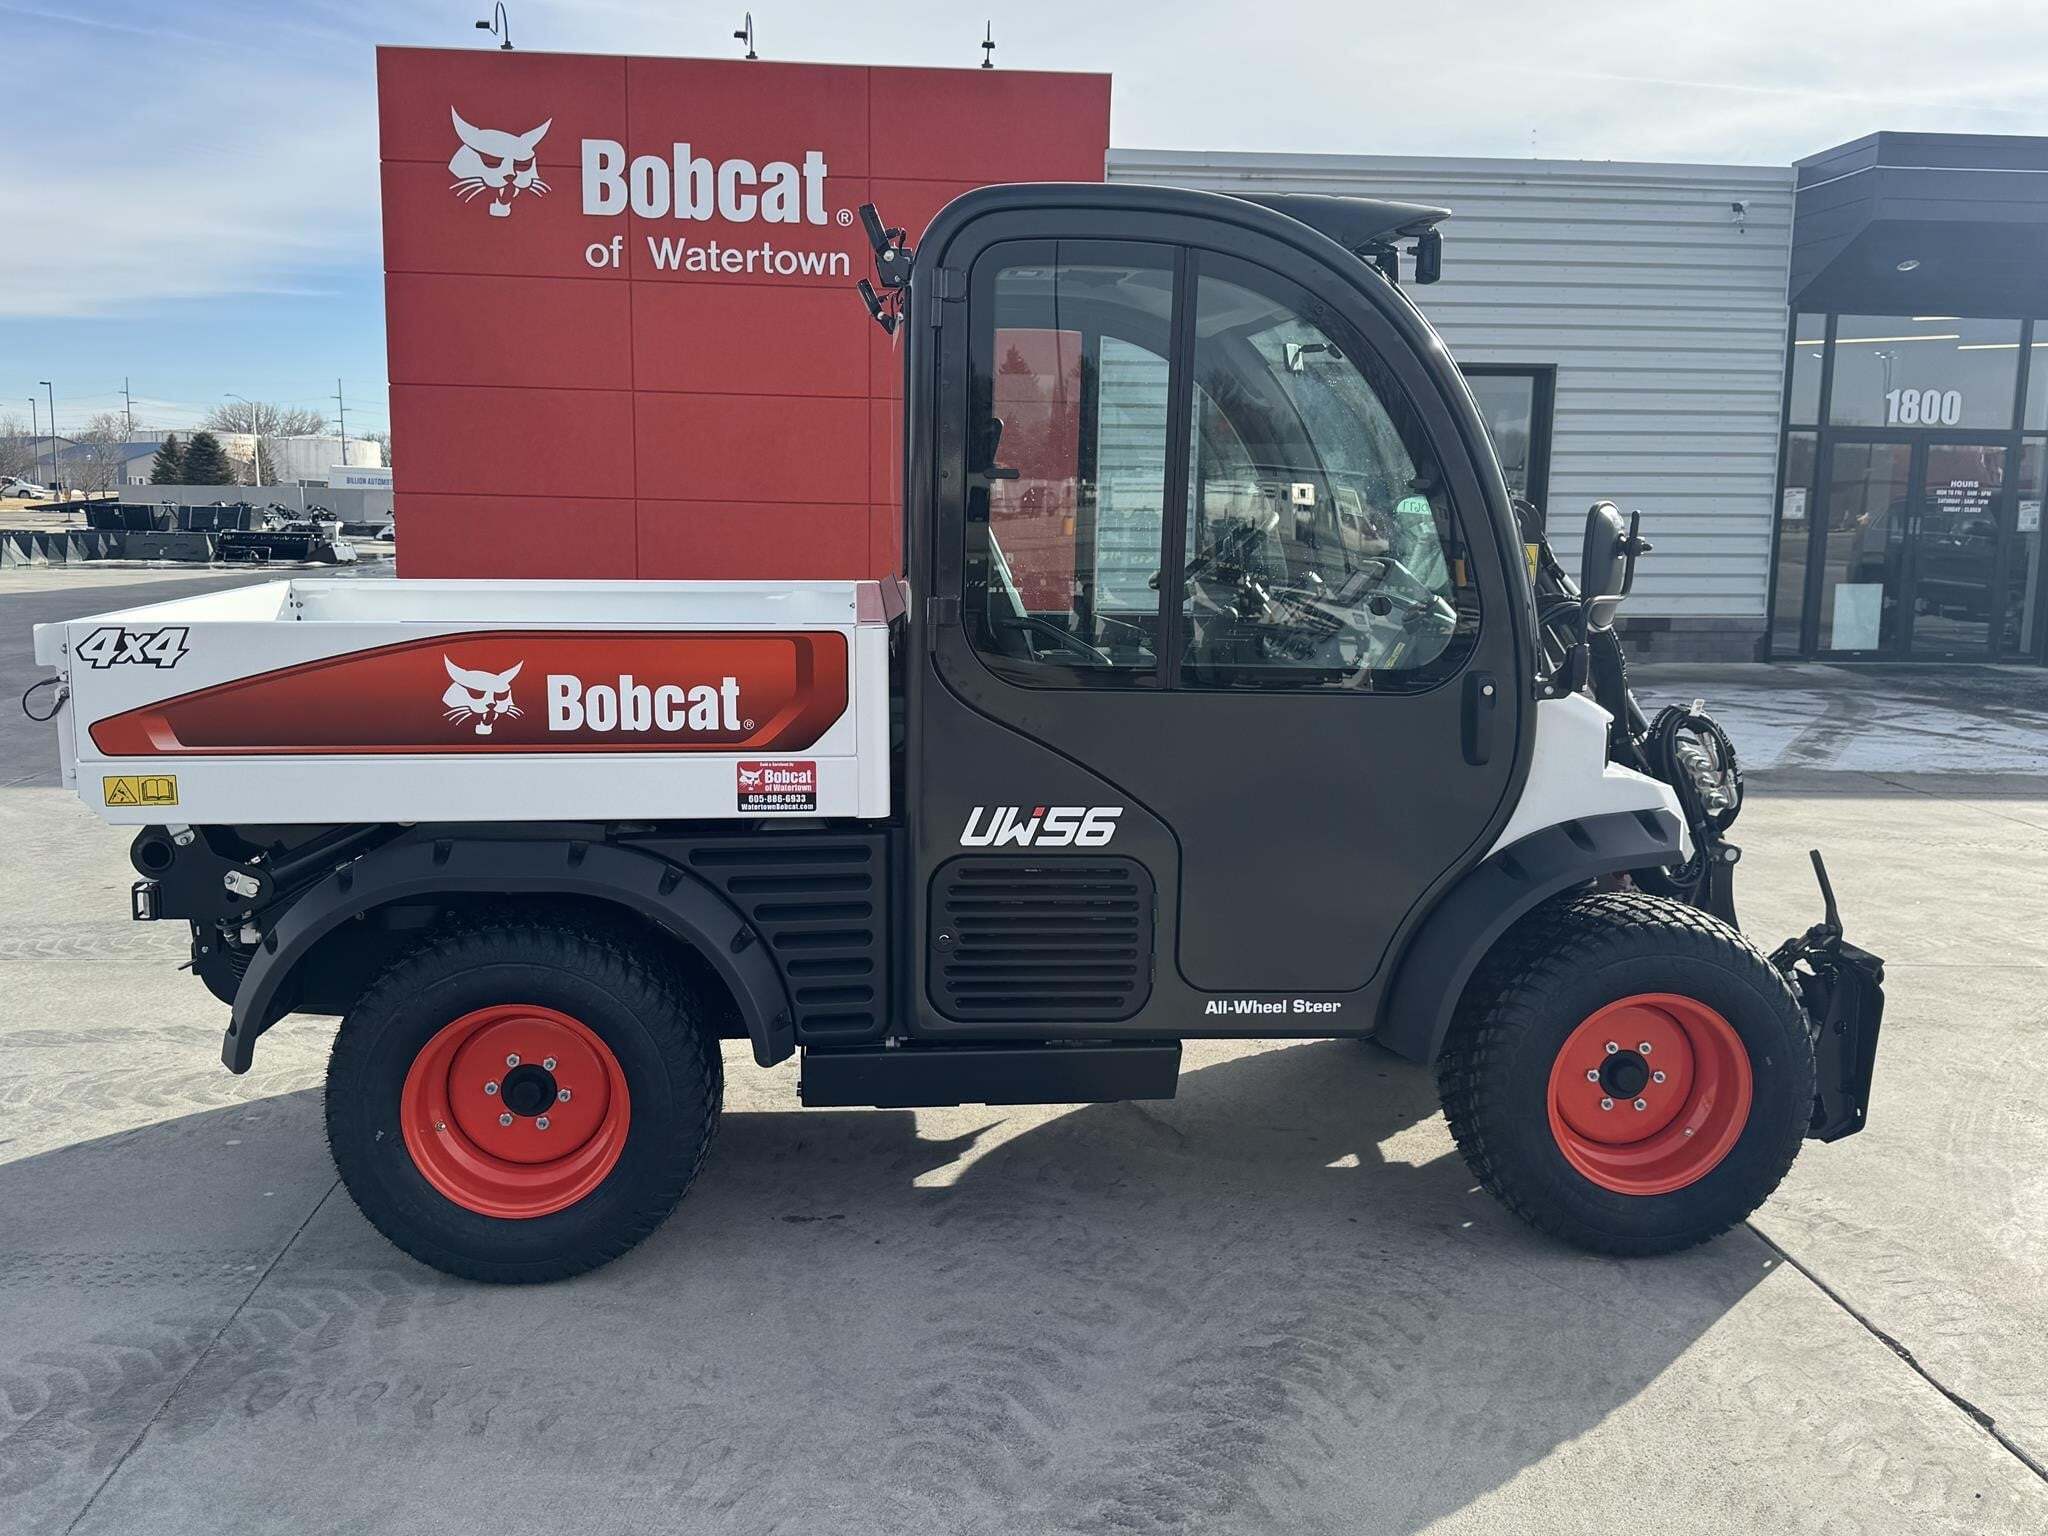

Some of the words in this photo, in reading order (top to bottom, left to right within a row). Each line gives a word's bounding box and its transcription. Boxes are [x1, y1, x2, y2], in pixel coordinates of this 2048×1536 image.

[581, 138, 828, 226] Bobcat
[585, 235, 624, 268] of
[647, 236, 851, 276] Watertown
[1886, 388, 1962, 425] 1800
[1950, 480, 1979, 488] HOURS
[75, 626, 190, 670] 4x4
[546, 674, 741, 732] Bobcat
[764, 769, 812, 784] Bobcat
[764, 783, 772, 792] of
[773, 783, 812, 792] Watertown
[741, 803, 814, 811] WatertownBobcat.com
[1204, 999, 1288, 1015] All-Wheel
[1292, 998, 1342, 1014] Steer
